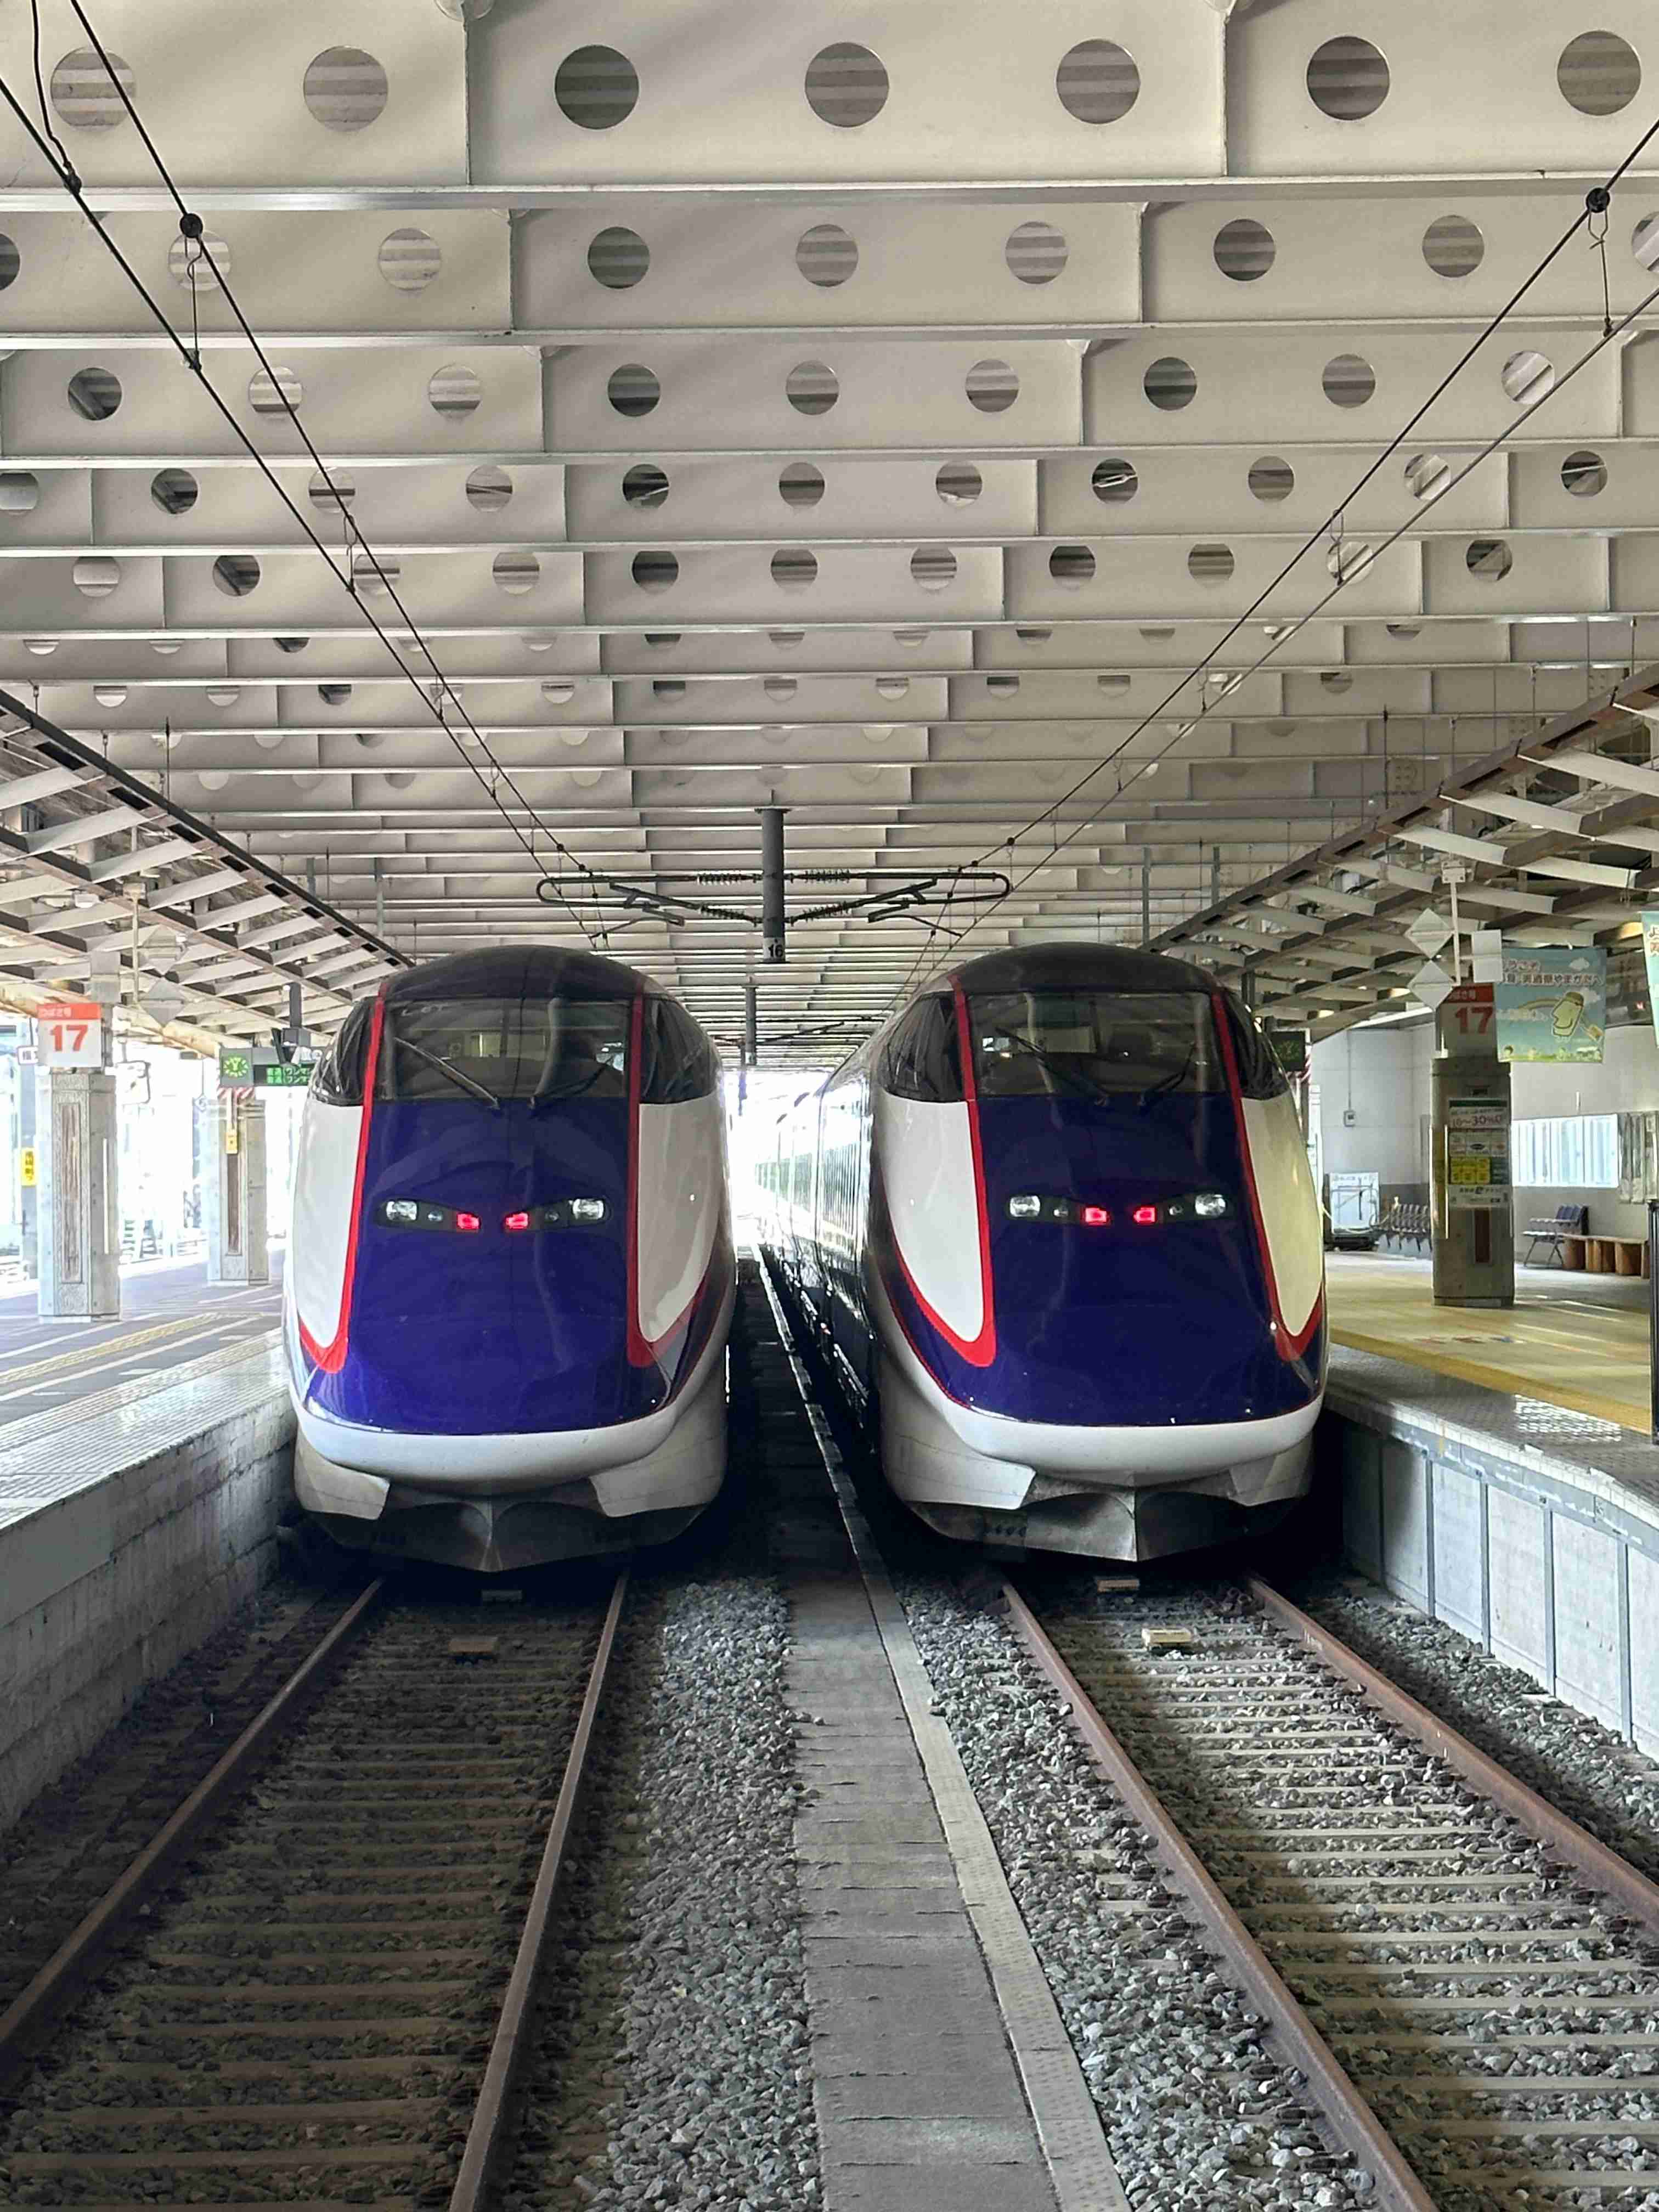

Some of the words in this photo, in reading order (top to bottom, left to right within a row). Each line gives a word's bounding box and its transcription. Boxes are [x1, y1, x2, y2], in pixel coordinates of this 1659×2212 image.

[768, 944, 783, 957] 16
[1455, 1007, 1493, 1033] 17
[50, 1024, 88, 1051] 17
